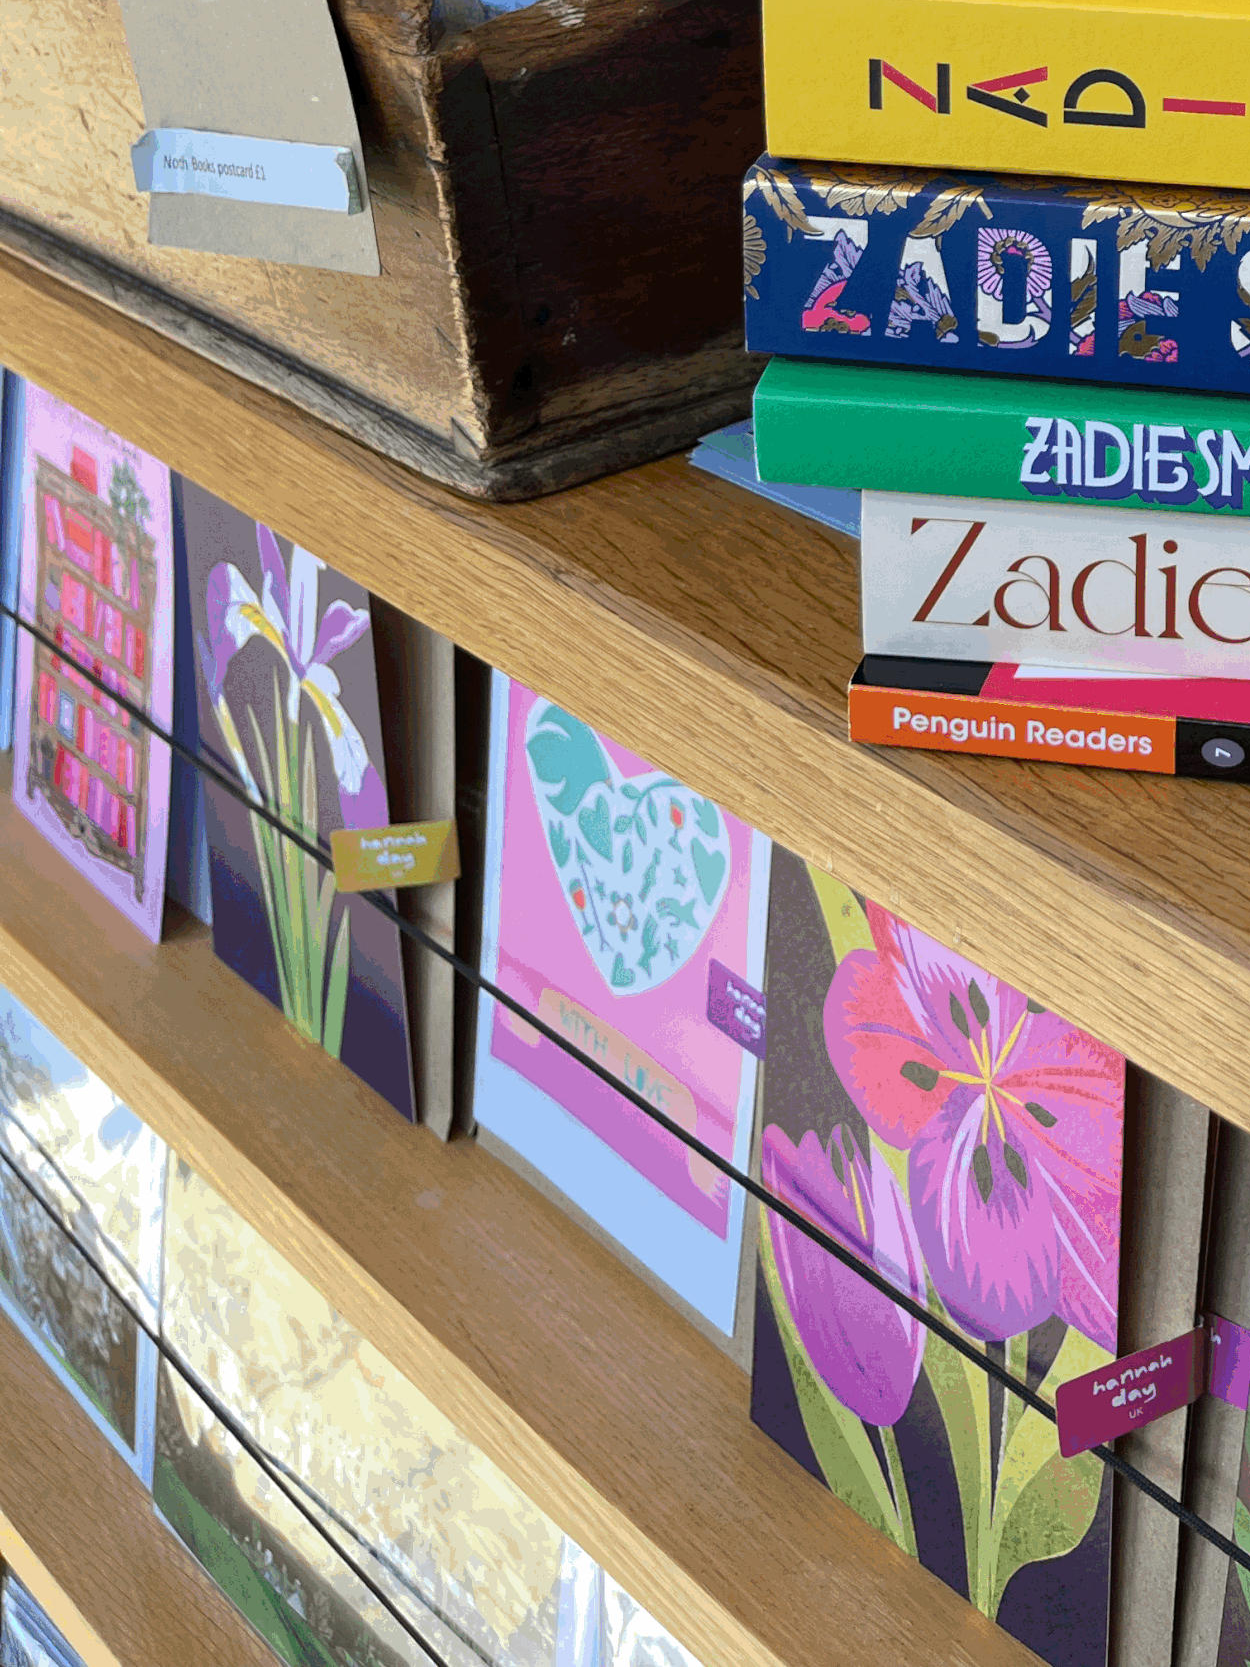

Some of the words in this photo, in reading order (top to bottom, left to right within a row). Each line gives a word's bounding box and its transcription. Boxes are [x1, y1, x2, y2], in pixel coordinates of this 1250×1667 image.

[191, 155, 216, 174] Books
[217, 162, 254, 179] postcard
[801, 215, 1181, 364] ZADIE
[1019, 416, 1190, 504] ZADIE
[892, 706, 1016, 742] Penguin
[1026, 719, 1153, 755] Readers
[1092, 1354, 1173, 1396] hannah
[1111, 1382, 1157, 1407] day
[1128, 1406, 1145, 1419] UK
